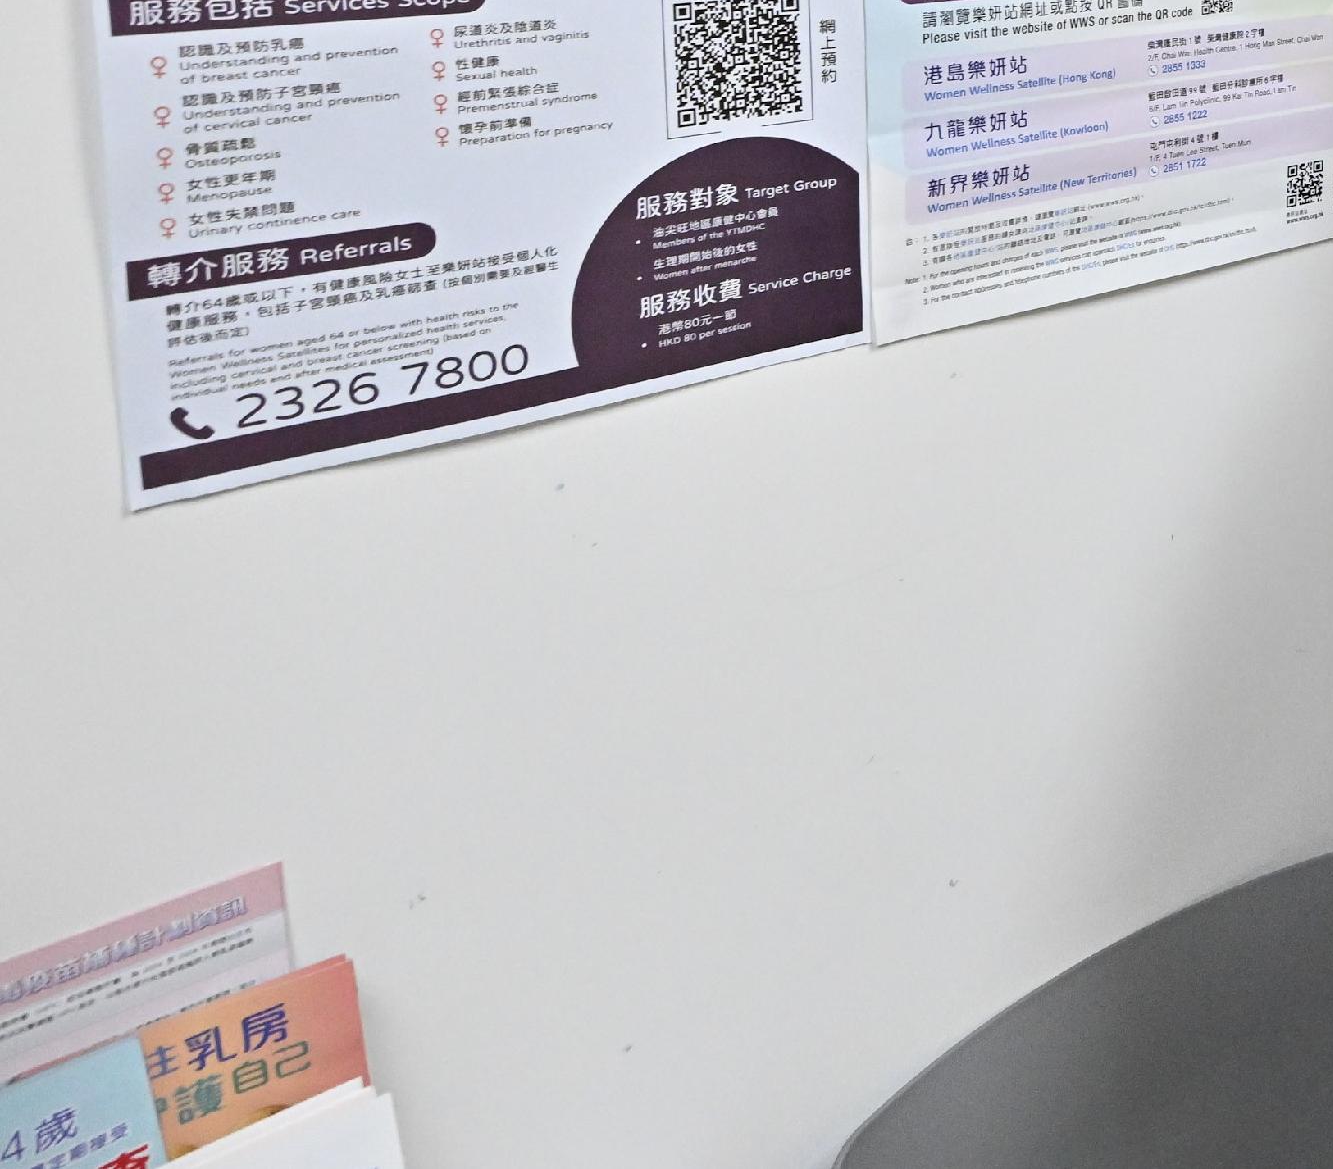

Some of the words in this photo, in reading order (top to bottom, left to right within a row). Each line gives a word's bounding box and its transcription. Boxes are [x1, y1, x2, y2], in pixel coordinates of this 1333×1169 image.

[180, 54, 289, 70] Understanding
[294, 51, 320, 62] and
[326, 46, 398, 60] prevention
[924, 55, 1027, 86] 港島樂妍站
[180, 74, 195, 85] of
[202, 69, 248, 82] breast
[252, 67, 301, 78] cancer
[456, 71, 496, 82] Sexual
[501, 66, 538, 77] health
[458, 96, 538, 114] Premenstrual
[542, 91, 597, 106] syndrome
[925, 110, 1028, 142] 九龍樂妍站
[185, 150, 280, 170] Osteoporosis
[186, 186, 272, 204] Menopause
[927, 164, 1030, 198] 新界樂妍站
[636, 183, 739, 220] 服務對象
[745, 182, 789, 200] Target
[794, 178, 837, 192] Group
[147, 247, 290, 288] 轉介服務
[301, 237, 412, 266] Referrals
[640, 279, 742, 319] 服務收費
[749, 275, 798, 294] Service
[803, 266, 852, 284] Charge
[236, 372, 379, 428] 2326
[400, 344, 530, 396] 7800
